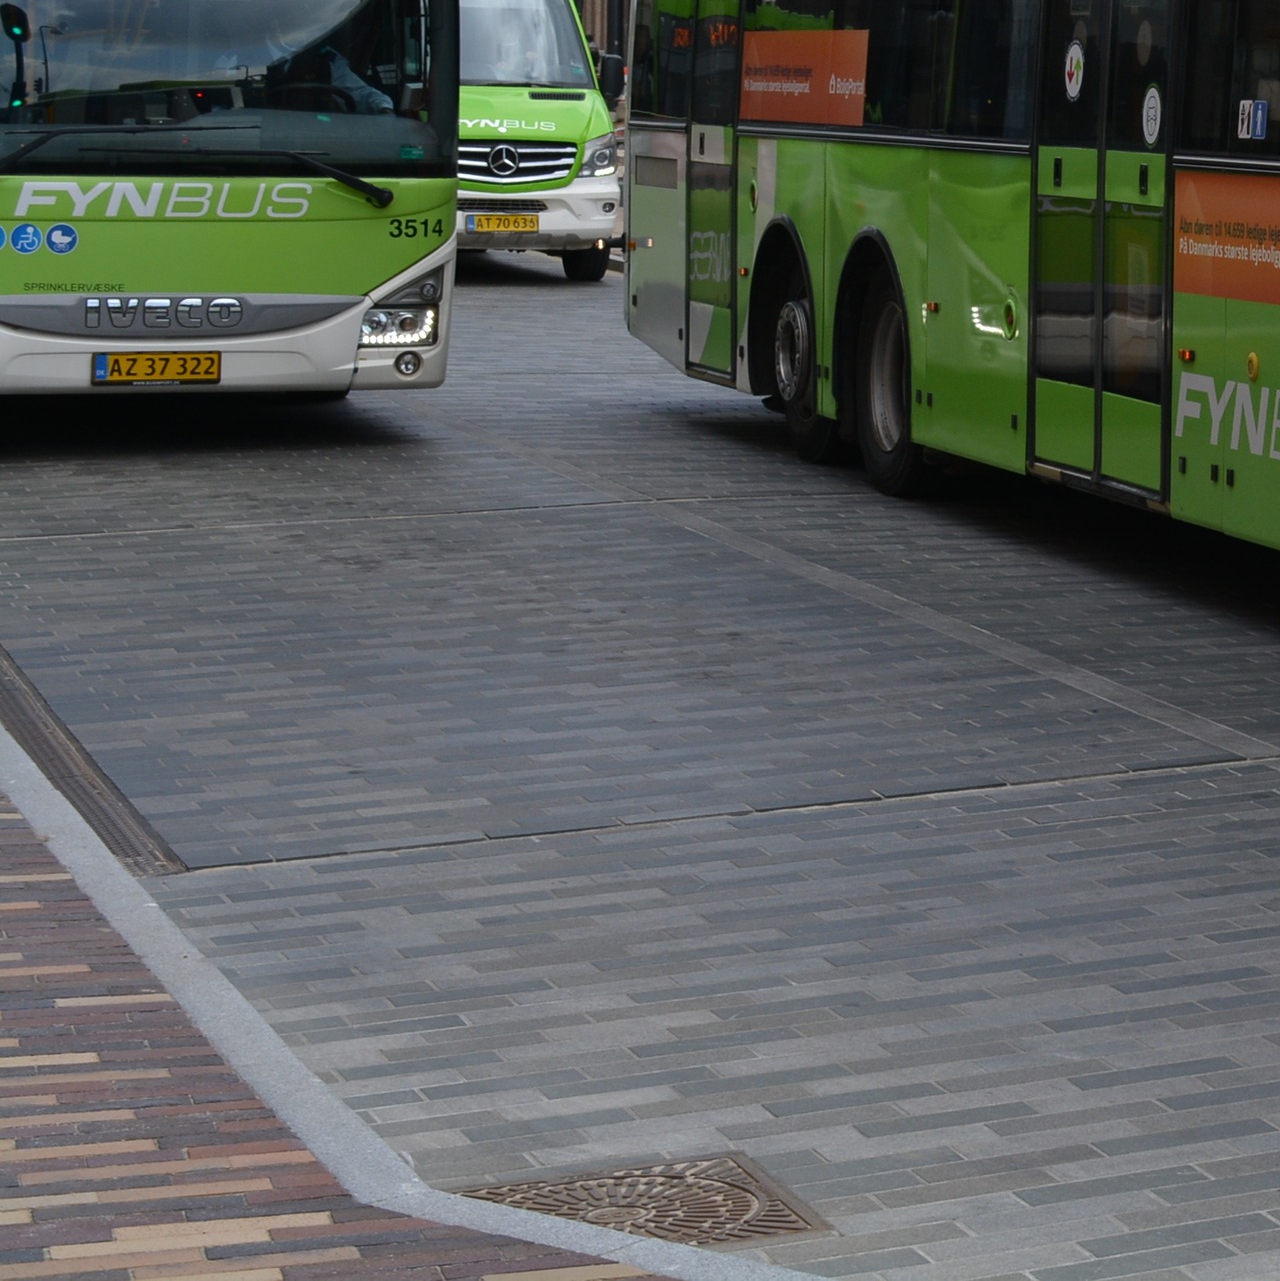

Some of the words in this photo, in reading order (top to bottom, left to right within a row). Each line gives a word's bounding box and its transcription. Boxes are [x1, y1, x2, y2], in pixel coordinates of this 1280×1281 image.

[14, 182, 313, 218] FYNBUS
[389, 218, 443, 238] 3514
[476, 218, 492, 230] AT
[495, 218, 511, 229] 70
[1179, 237, 1189, 254] På
[1189, 239, 1223, 258] Danmarks
[1224, 244, 1248, 261] største
[23, 281, 125, 293] SPRINKLERVÆSKE
[84, 297, 244, 329] IVECO
[109, 358, 138, 376] AZ
[144, 357, 171, 376] 37
[176, 356, 216, 375] 322
